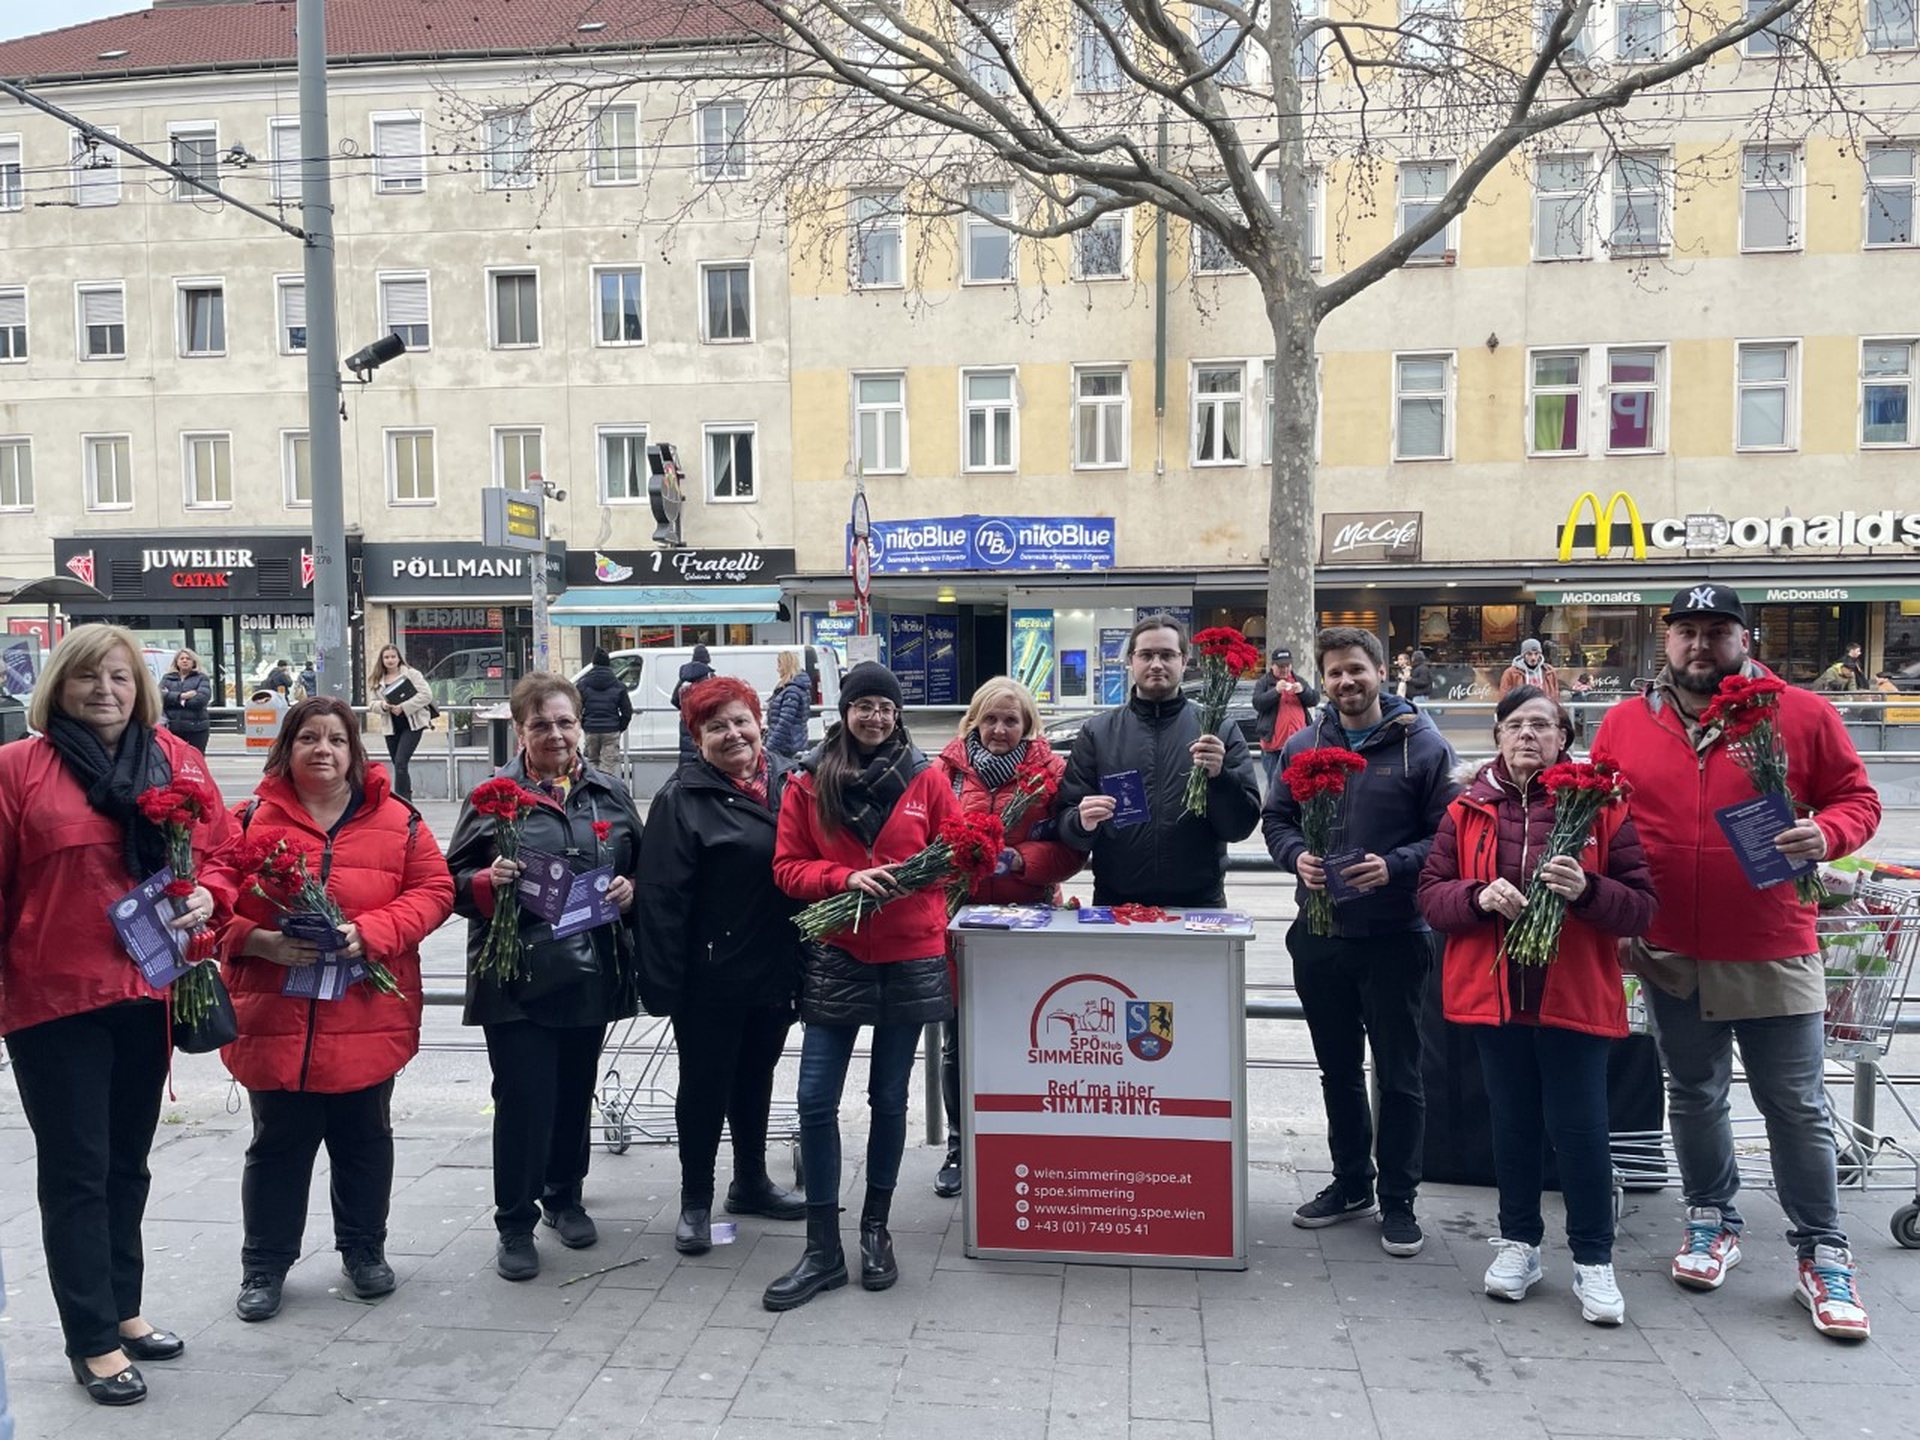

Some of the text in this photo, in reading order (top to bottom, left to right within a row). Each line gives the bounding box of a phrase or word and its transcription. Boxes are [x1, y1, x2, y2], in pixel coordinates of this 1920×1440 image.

[886, 525, 967, 550] nikoBlue
[1019, 524, 1111, 548] nikoBlue
[142, 549, 255, 572] JUWELIER
[672, 551, 765, 574] Fratelli
[1561, 591, 1642, 604] McDonald's
[1686, 586, 1716, 609] NY
[1766, 588, 1849, 601] McDonald's
[239, 614, 314, 630] Gold Ankau
[1070, 1034, 1122, 1050] SPÖ Klub
[1028, 1050, 1124, 1066] SIMMERING
[1117, 1081, 1155, 1099] über
[1042, 1097, 1161, 1116] SIMMERING
[1034, 1167, 1192, 1185] wien.simmering@spoe.at
[1034, 1186, 1135, 1202] spoe.simmering
[1034, 1203, 1206, 1221] www.simmering.spoe.wien
[1034, 1220, 1149, 1236] +43 (01) 749 05 41
